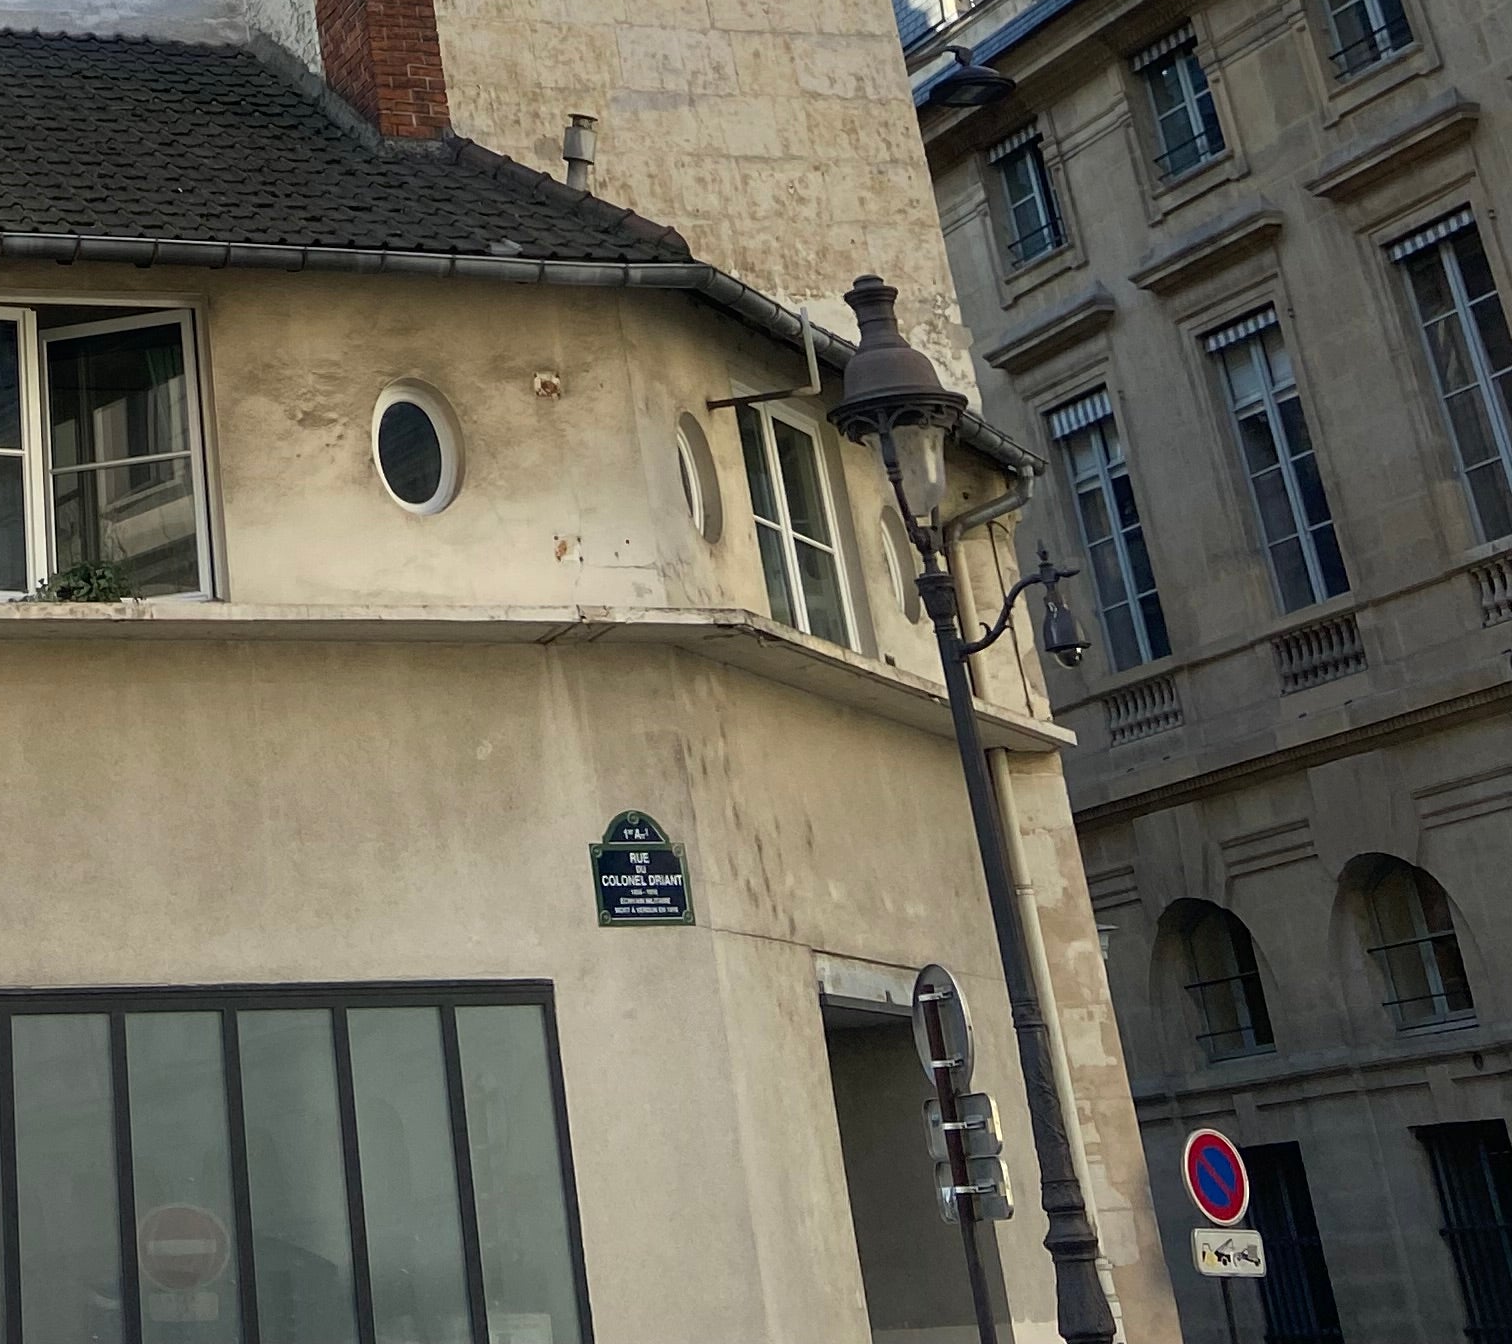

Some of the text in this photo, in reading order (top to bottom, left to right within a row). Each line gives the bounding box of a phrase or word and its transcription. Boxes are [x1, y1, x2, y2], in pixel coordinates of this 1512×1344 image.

[629, 852, 650, 864] RUE
[635, 865, 647, 874] DU
[601, 874, 683, 887] COLONEL DRIANT
